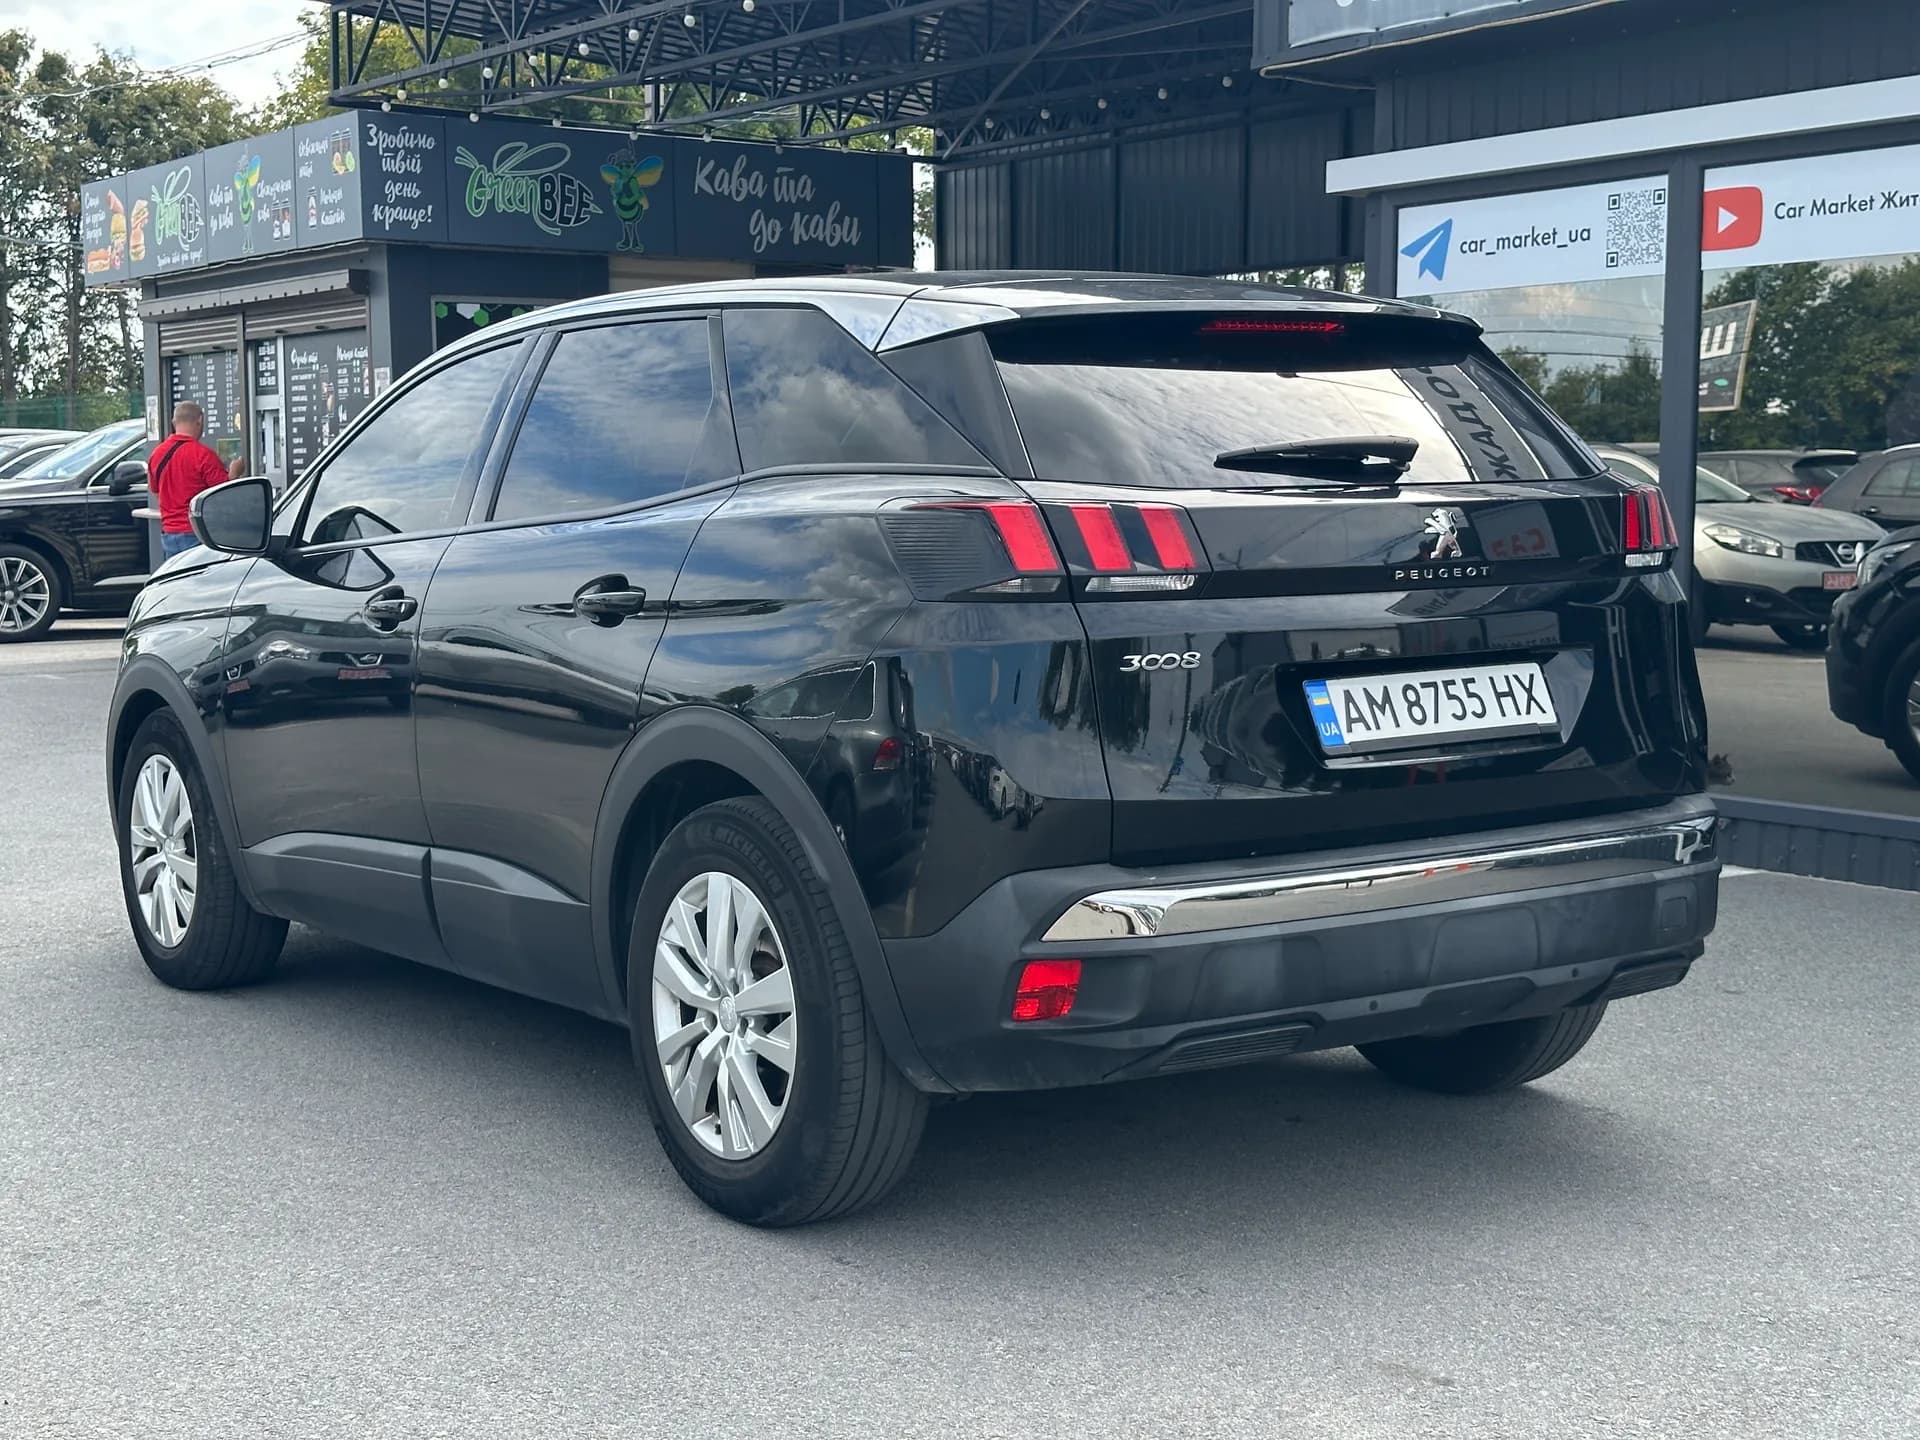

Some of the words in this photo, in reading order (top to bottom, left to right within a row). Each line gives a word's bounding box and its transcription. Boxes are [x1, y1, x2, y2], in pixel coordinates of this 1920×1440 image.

[366, 123, 437, 156] Зробимо
[381, 149, 423, 174] твій
[384, 180, 422, 204] день
[694, 154, 768, 202] Кава
[773, 166, 816, 204] та
[1774, 202, 1805, 220] Car
[1810, 193, 1876, 217] Market
[1880, 190, 1920, 210] Жит
[371, 203, 433, 231] краще!
[750, 208, 783, 253] до
[790, 200, 862, 247] кави
[1460, 225, 1592, 256] car_market_ua
[1394, 566, 1490, 580] PEUGEOT
[1120, 651, 1202, 672] 3008
[1343, 685, 1401, 733] AM
[1402, 677, 1487, 726] 8755
[1488, 673, 1547, 718] HX
[1321, 721, 1340, 737] UA
[711, 823, 788, 899] MICHELIN
